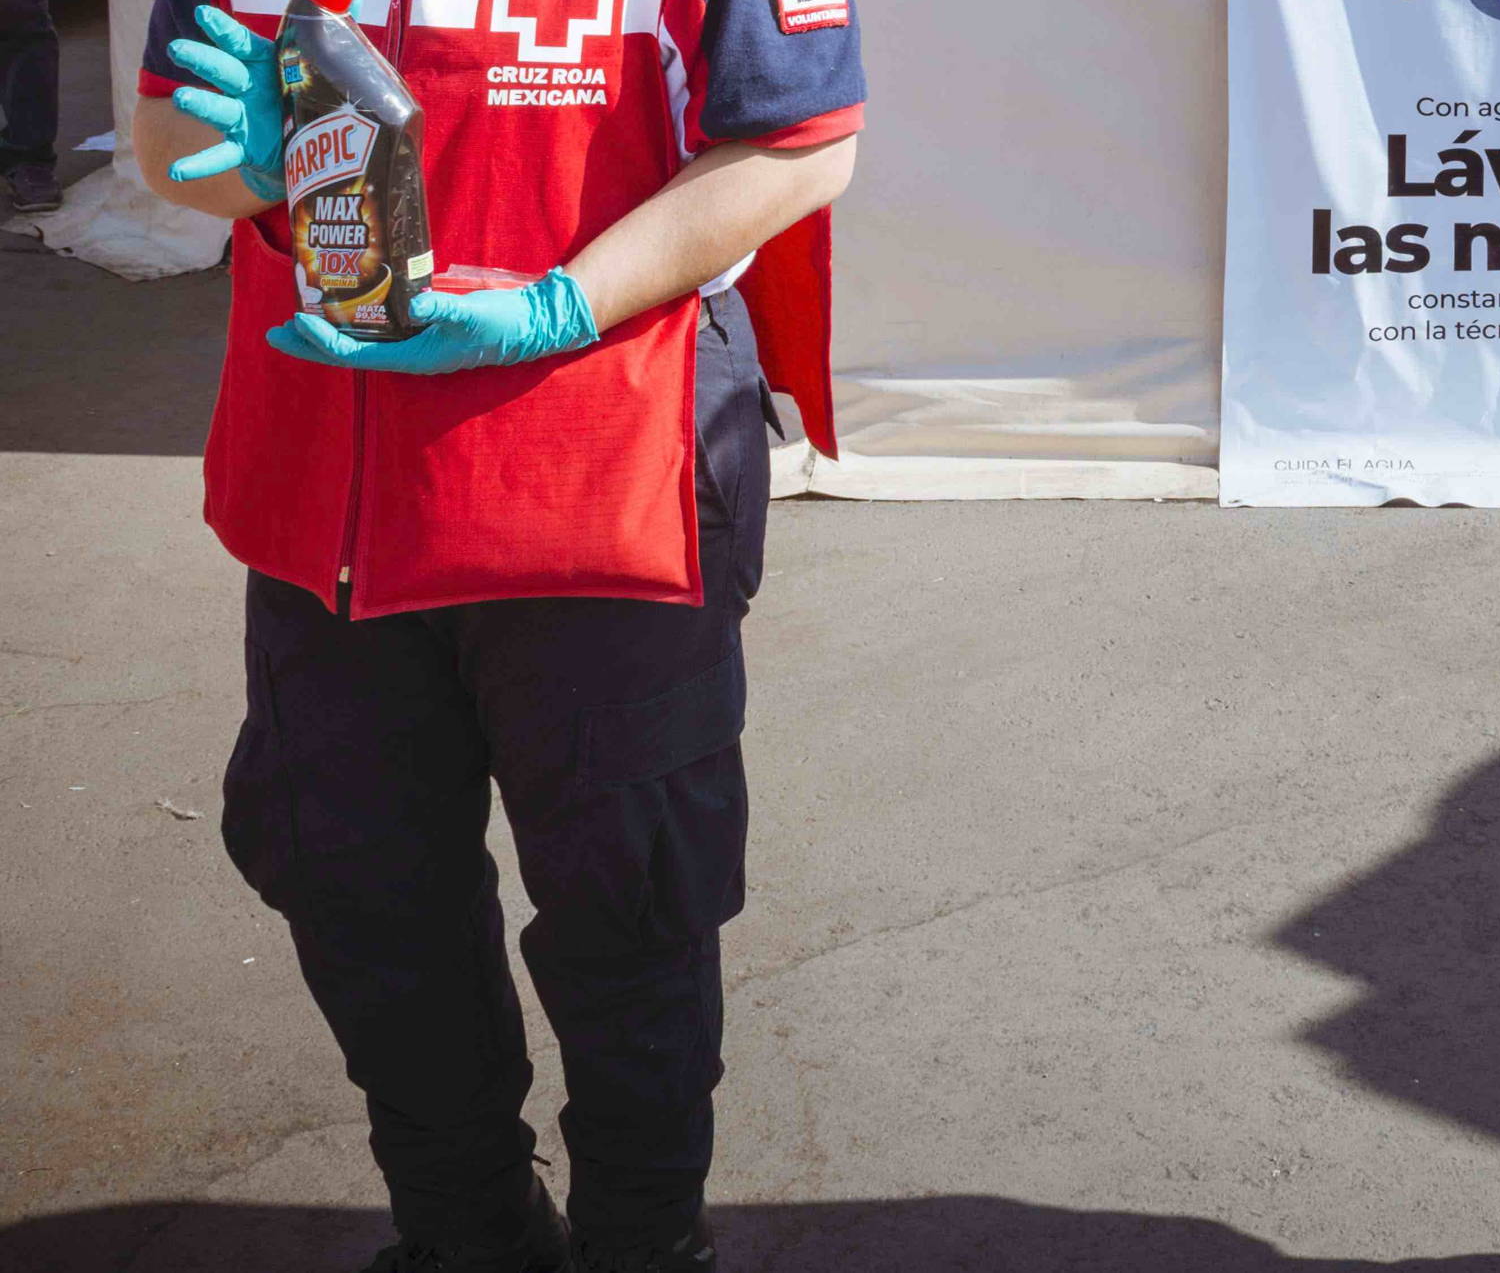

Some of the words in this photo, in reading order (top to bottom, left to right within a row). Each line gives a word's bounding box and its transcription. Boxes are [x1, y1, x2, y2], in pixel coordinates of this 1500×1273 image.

[486, 66, 549, 84] CRUZ
[551, 68, 606, 85] ROJA
[487, 88, 608, 106] MEXICANA
[1415, 97, 1469, 117] Con
[286, 123, 356, 194] HARPIC
[314, 196, 363, 221] MAX
[309, 224, 367, 245] POWER
[1311, 208, 1432, 275] las
[318, 251, 362, 276] 10X
[357, 304, 387, 312] MATA
[1368, 326, 1417, 342] con
[1425, 320, 1447, 341] la
[1274, 459, 1331, 471] CUIDA
